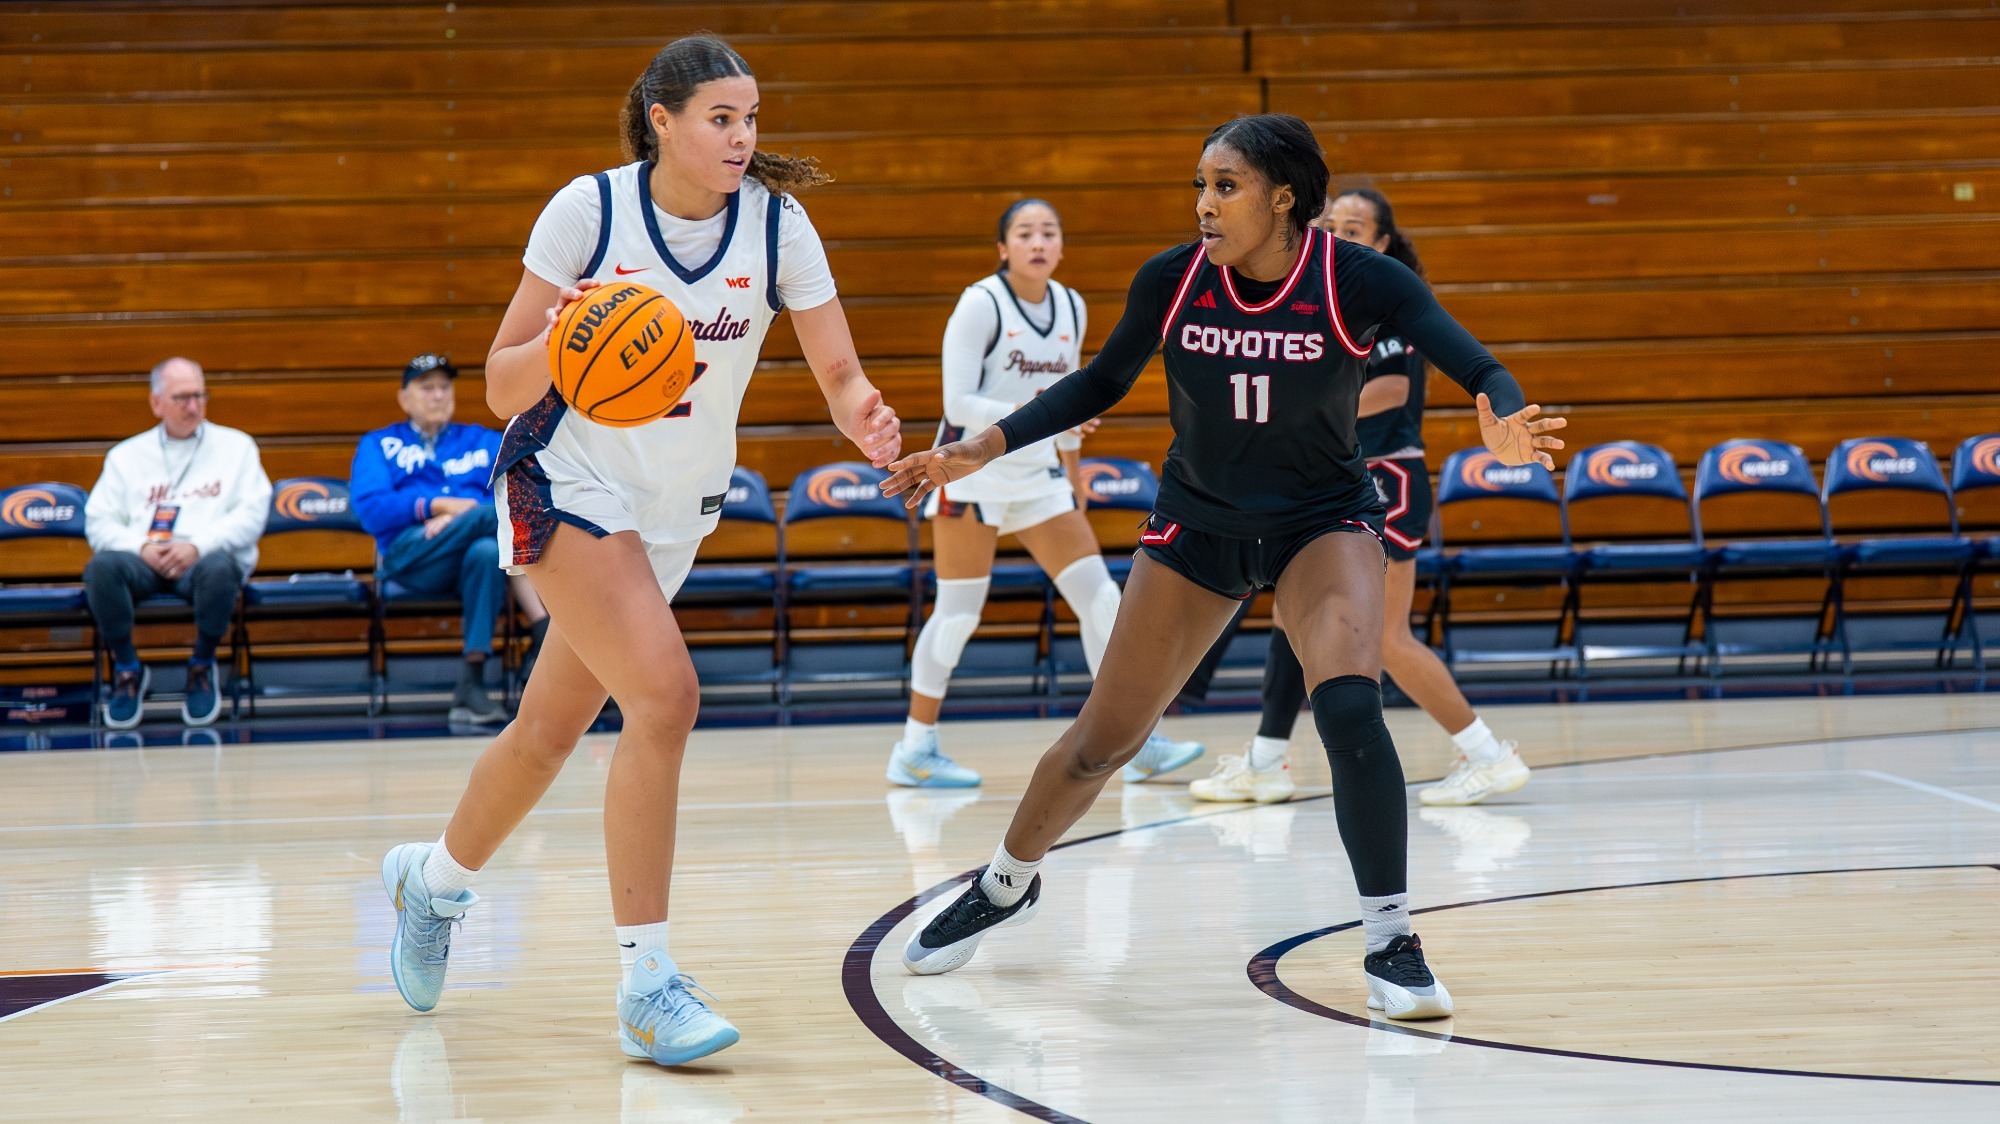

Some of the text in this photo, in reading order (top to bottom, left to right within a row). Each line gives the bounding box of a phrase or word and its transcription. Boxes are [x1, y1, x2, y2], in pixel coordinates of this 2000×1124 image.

[725, 277, 750, 288] WCC
[566, 287, 643, 353] Wilson
[1181, 323, 1324, 361] COYOTES
[1229, 373, 1270, 423] 11
[1742, 460, 1789, 477] WAVES
[1870, 457, 1917, 475] WAVES
[26, 505, 75, 521] WAVES
[300, 497, 348, 514] WAVES
